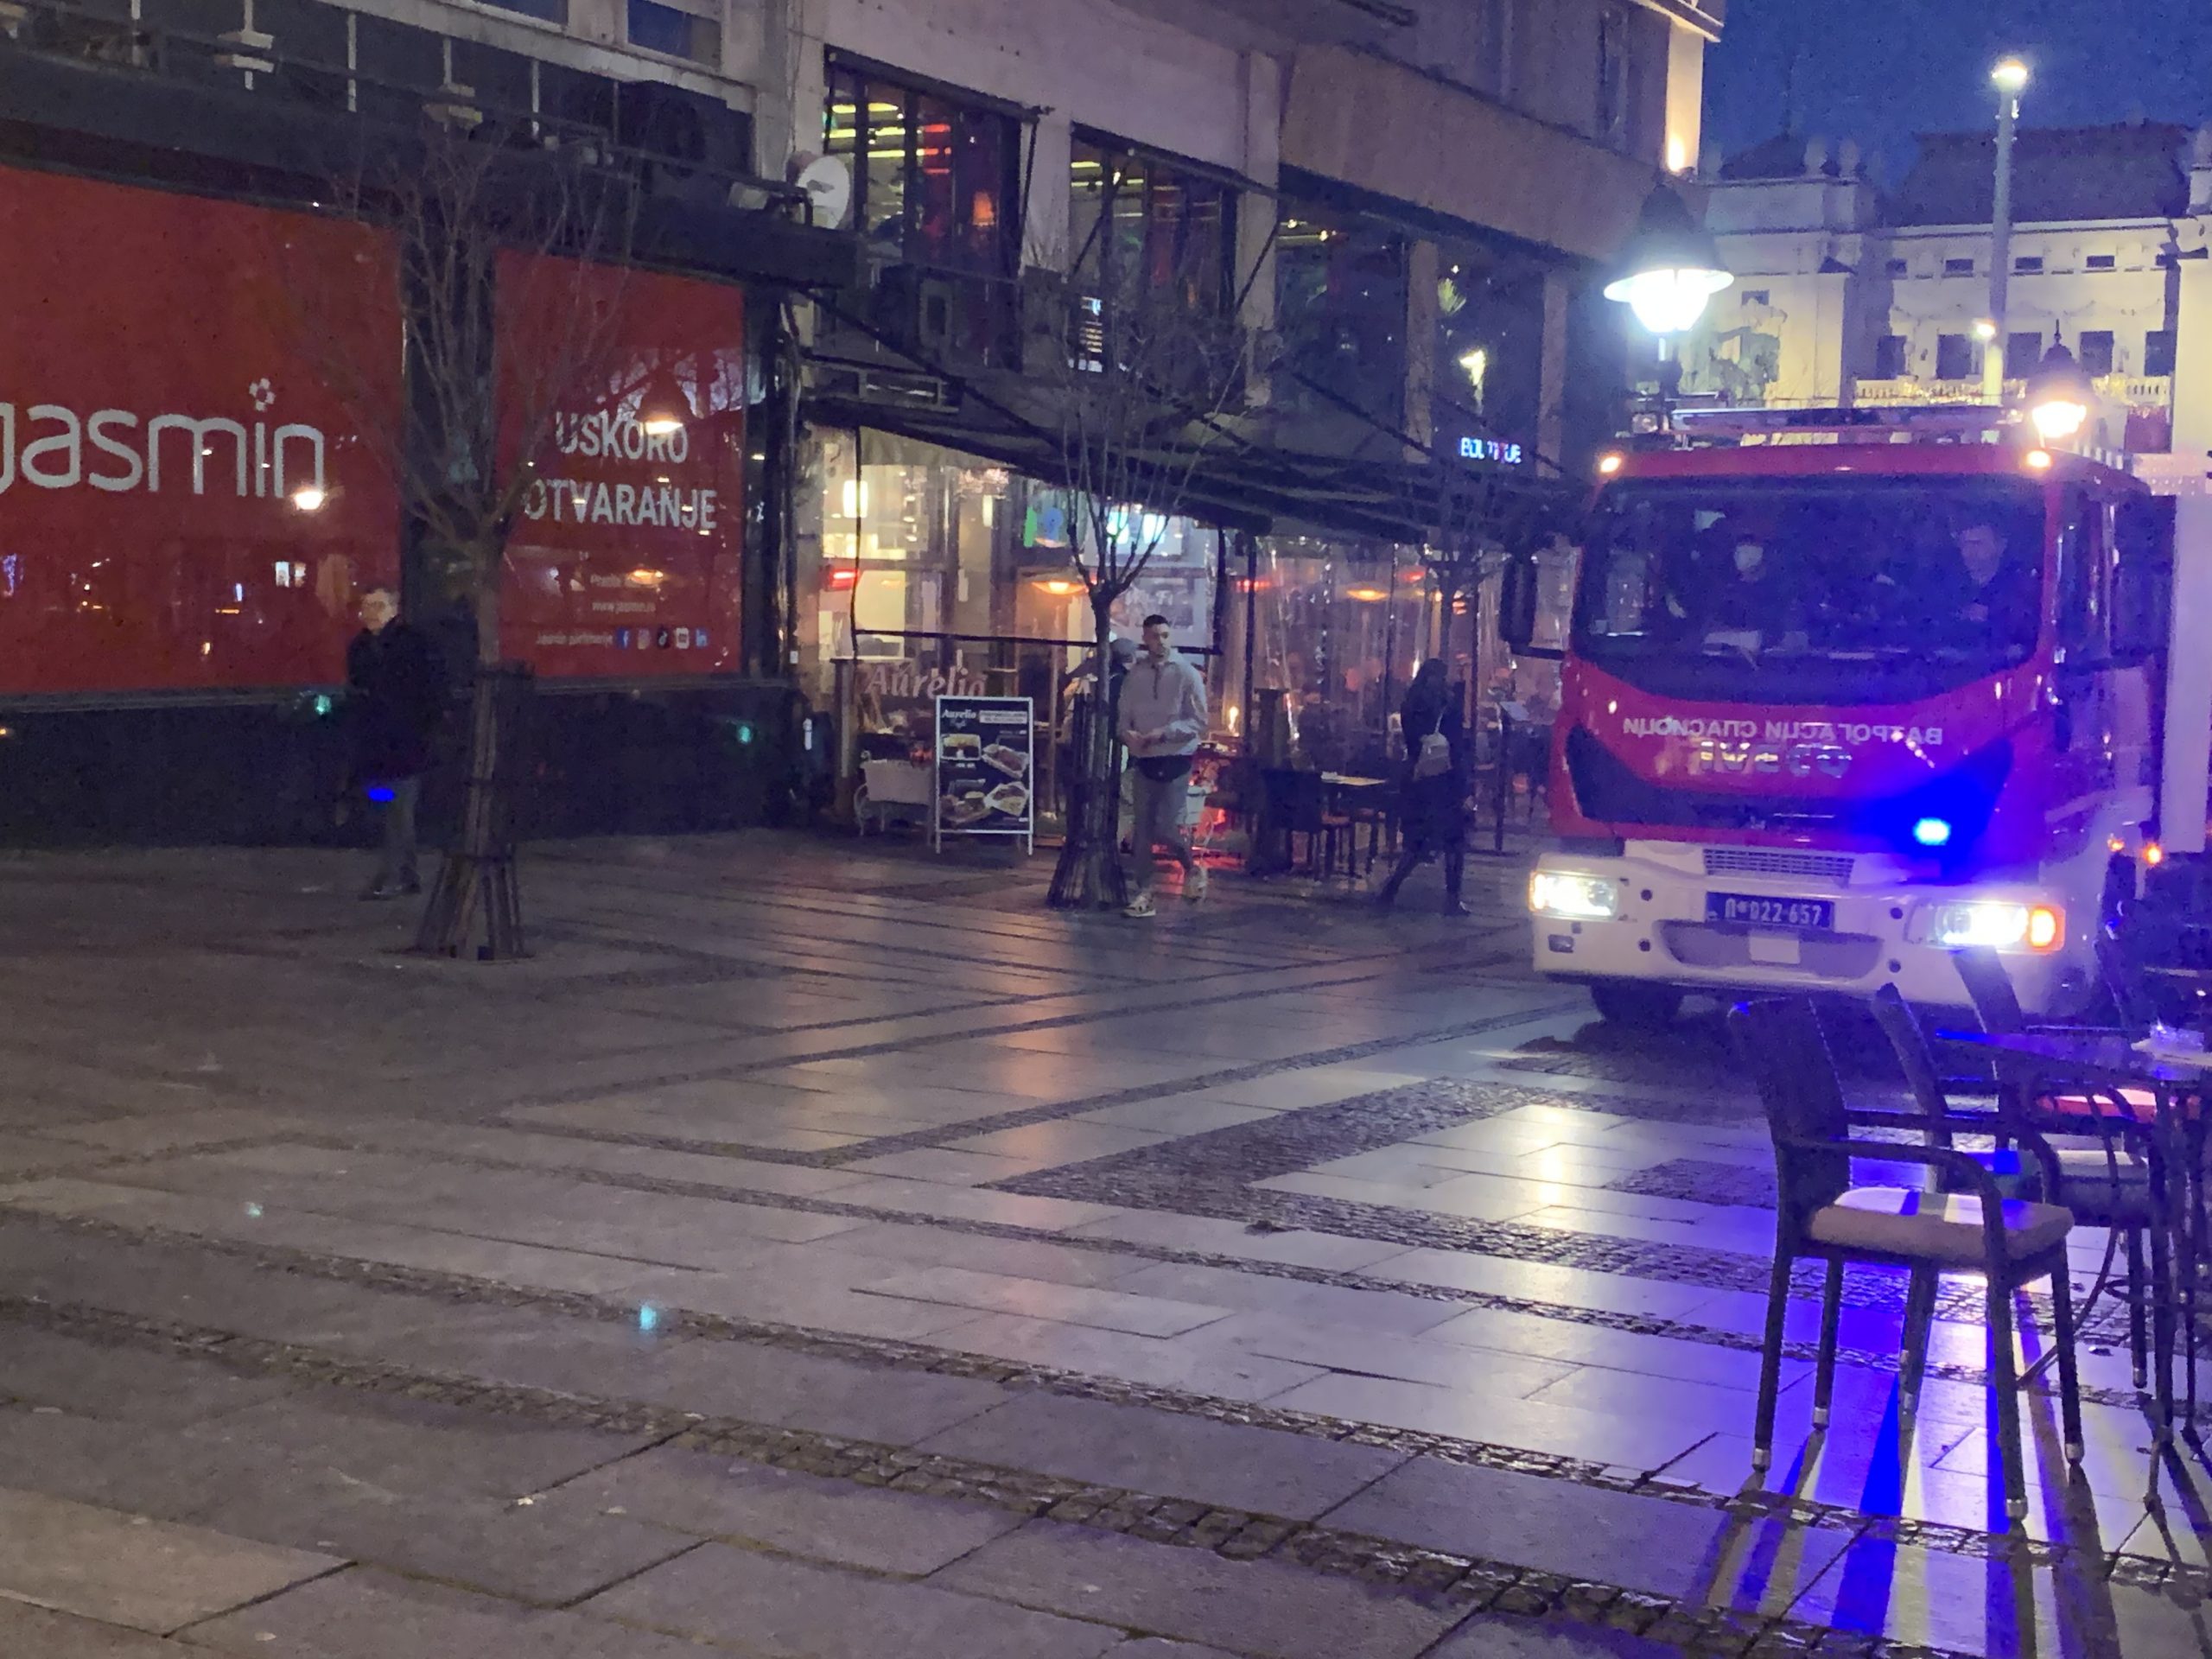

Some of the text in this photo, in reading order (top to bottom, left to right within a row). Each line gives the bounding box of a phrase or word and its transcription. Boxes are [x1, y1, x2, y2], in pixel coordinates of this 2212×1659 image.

[556, 410, 688, 463] USKORO
[522, 479, 718, 530] OTVARANJE
[864, 662, 988, 699] Aurelio
[941, 708, 977, 720] Aurelio
